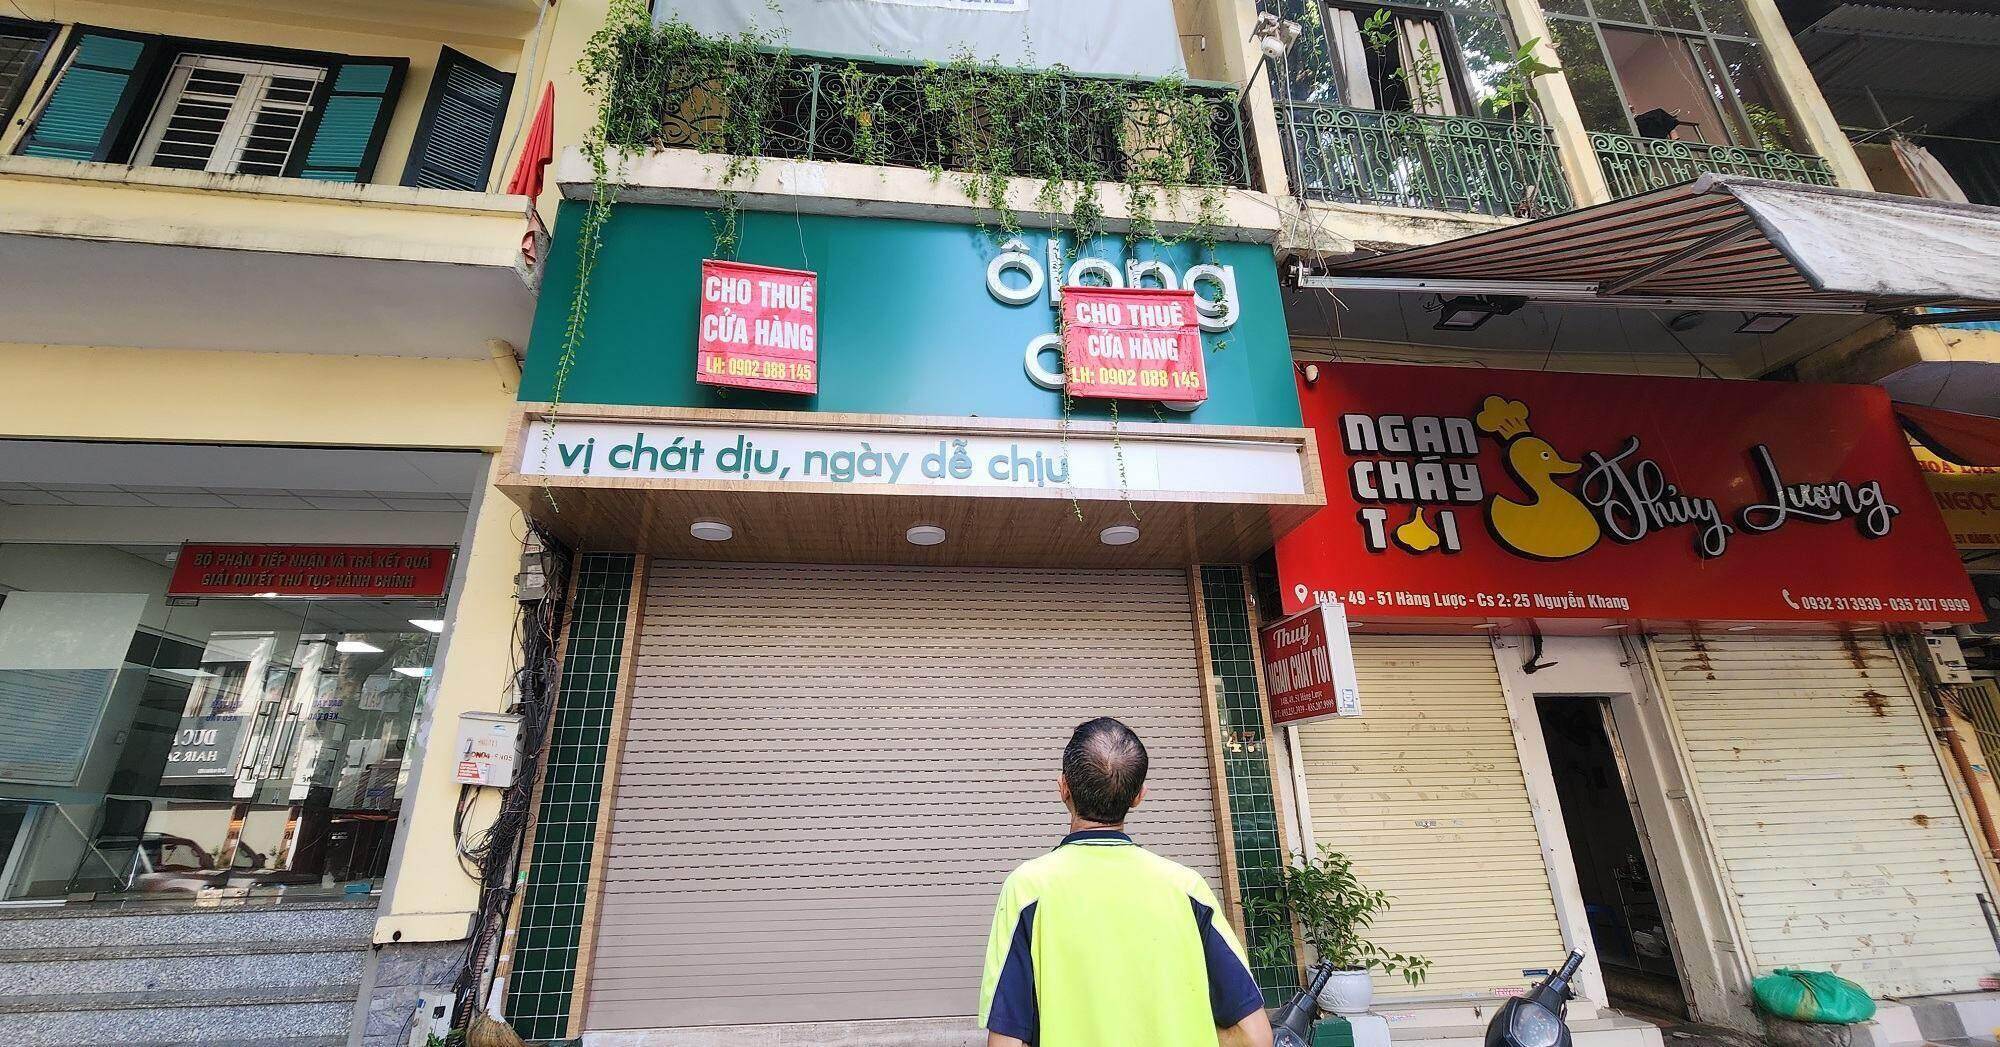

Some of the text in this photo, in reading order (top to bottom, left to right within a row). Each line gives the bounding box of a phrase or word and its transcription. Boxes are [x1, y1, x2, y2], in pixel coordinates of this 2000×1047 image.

[705, 276, 813, 313] CHO THUÊ
[1075, 301, 1185, 327] CHO THUÊ
[703, 307, 814, 352] CỬA HÀNG
[1087, 329, 1180, 361] CỬA HÀNG
[705, 355, 812, 381] LH: 0902 088 145
[1070, 366, 1200, 389] LH: 0902 088 145
[1343, 413, 1480, 454] NGAN
[558, 432, 1068, 488] vị chát dịu, ngày dễ chịu
[1352, 455, 1484, 501] CHÁY
[193, 551, 431, 570] BỘ PHẬN TIẾP NHẬN VÀ TRẢ KẾT QUẢ
[201, 568, 415, 590] GIẢI QUYẾT THỦ TỤC HÀNH CHÍNH
[1348, 590, 1366, 606] 49
[1376, 591, 1393, 606] 51
[1395, 591, 1431, 608] Hàng
[1433, 592, 1467, 609] Lược
[1477, 592, 1495, 607] Cs
[1497, 593, 1512, 608] 2:
[1514, 593, 1531, 608] 25
[1533, 591, 1586, 610] Nguyễn
[1587, 594, 1630, 610] Khang
[1801, 596, 1834, 610] 0932
[1890, 598, 1914, 611] 035
[1915, 598, 1938, 612] 207
[1939, 598, 1971, 612] 9999
[1267, 634, 1332, 696] NGAN CHÁY TỎI
[1226, 730, 1256, 753] 47
